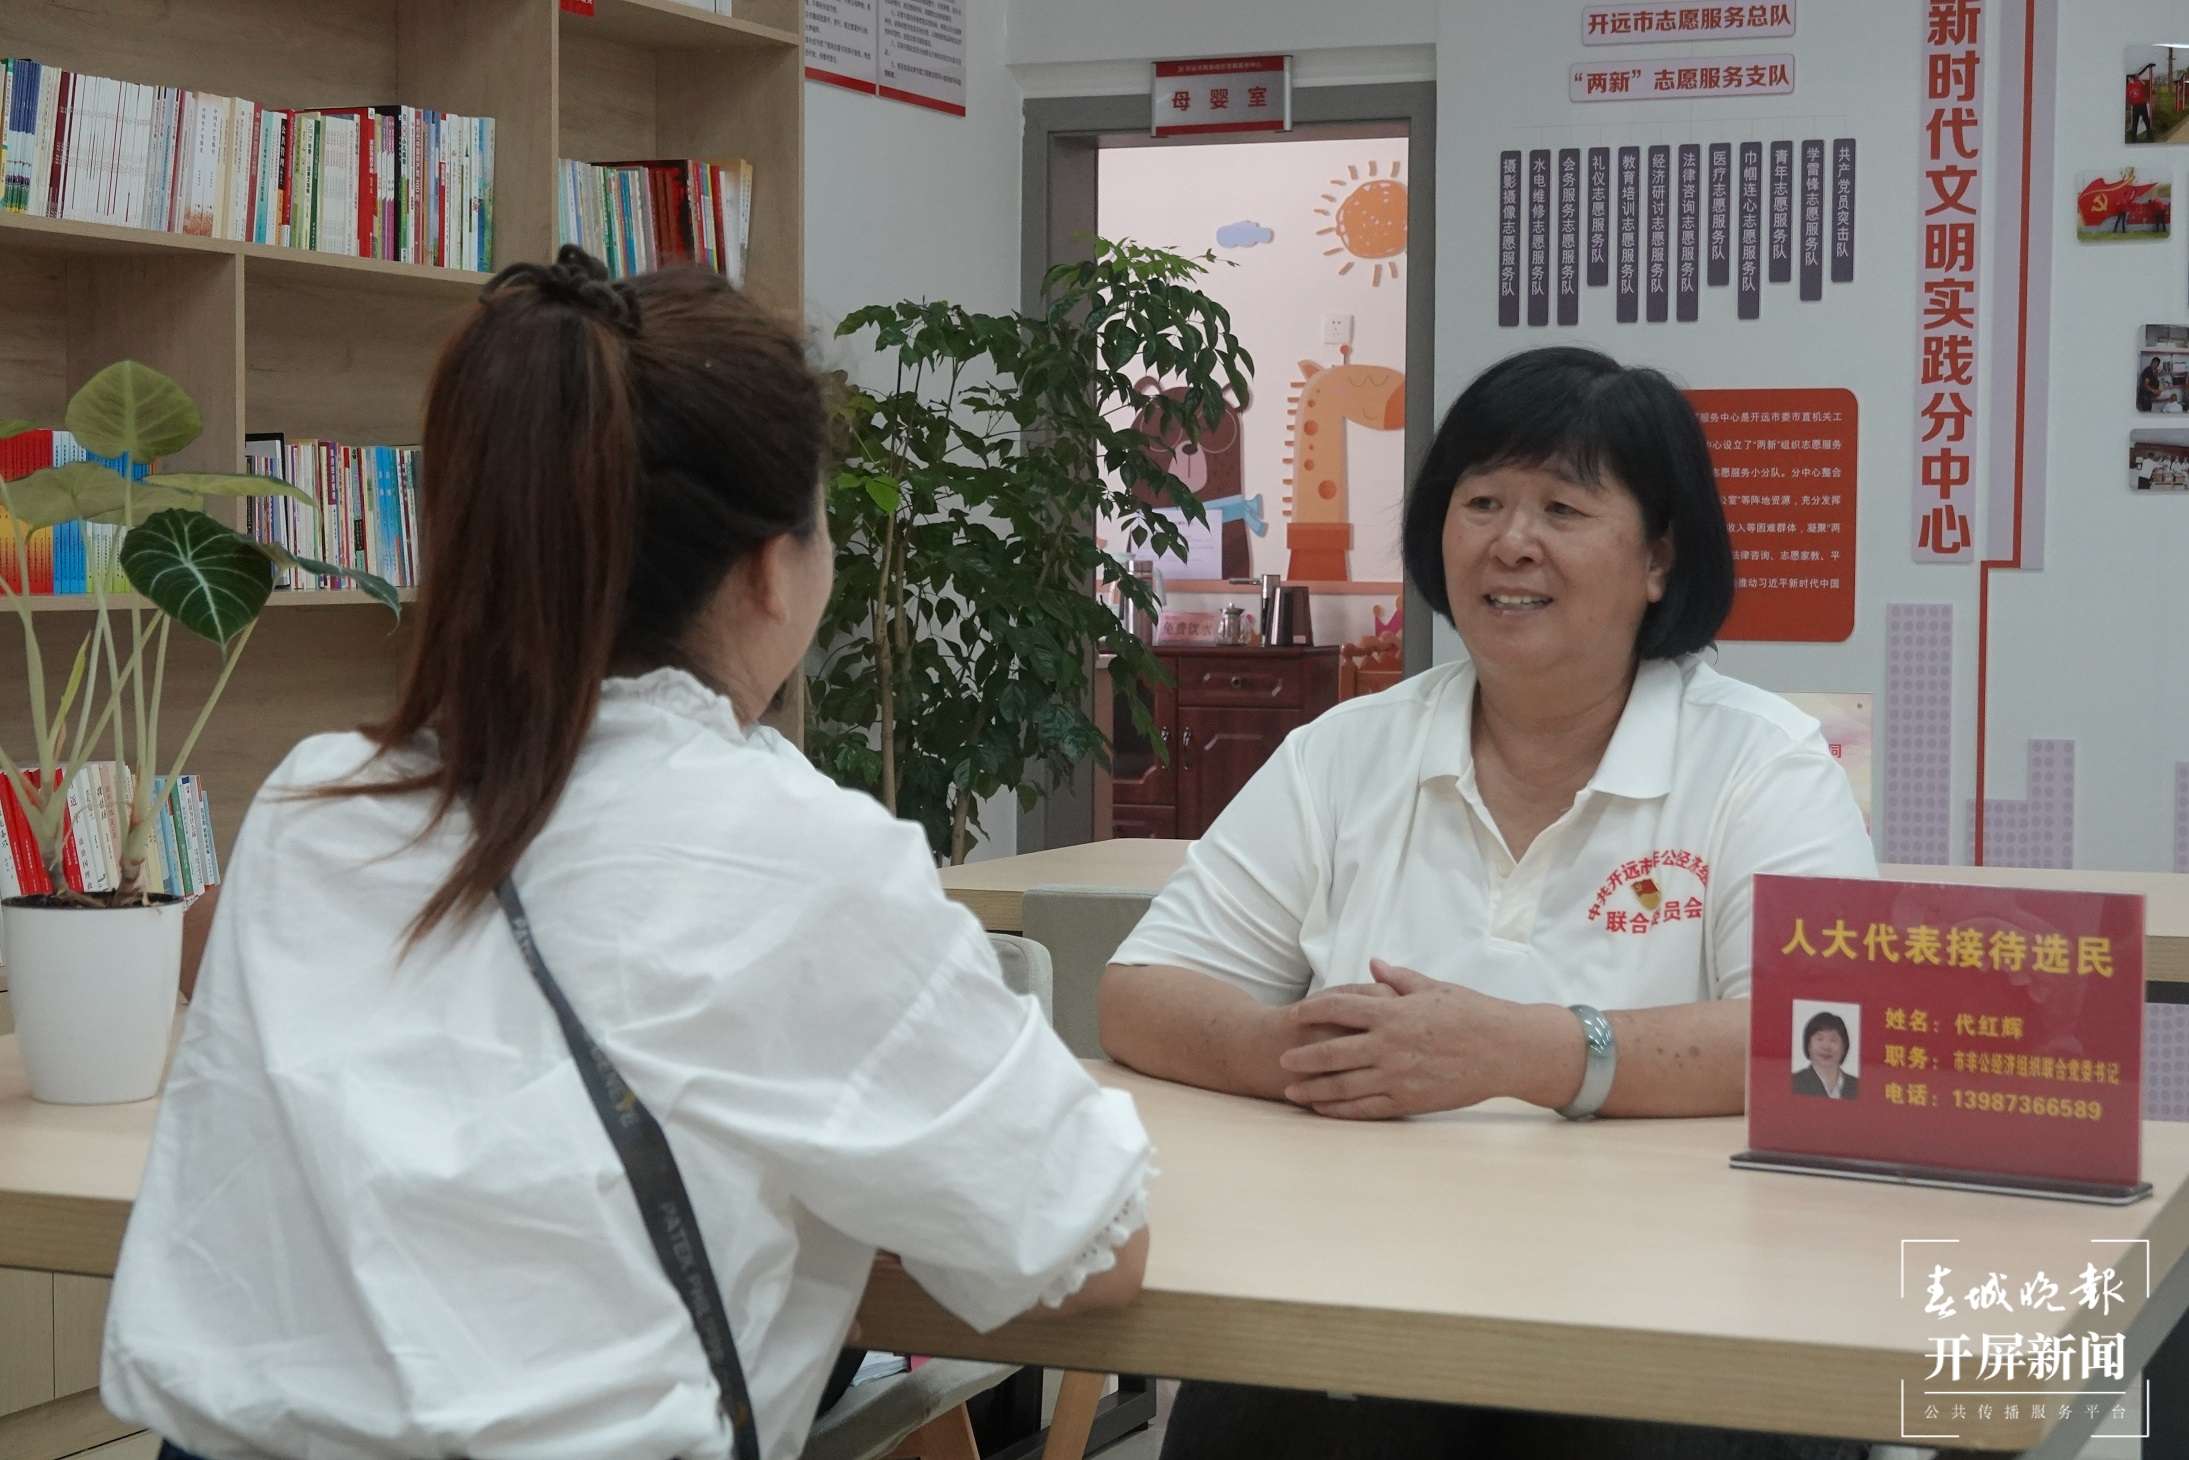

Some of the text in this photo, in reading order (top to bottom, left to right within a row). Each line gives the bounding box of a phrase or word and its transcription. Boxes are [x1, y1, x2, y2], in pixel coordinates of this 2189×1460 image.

[1588, 4, 1791, 35] 开远市志愿服务总队
[1171, 86, 1268, 111] 母婴室
[1501, 158, 1517, 296] 摄影摄像志愿服务队
[1531, 159, 1546, 295] 水电维修志愿服务队
[1561, 157, 1576, 295] 会务服务志愿服务队
[1591, 155, 1606, 263] 礼仪志愿服务队
[1621, 154, 1636, 294] 教育培训志愿服务队
[1650, 154, 1666, 293] 经济研讨志愿服务队
[1680, 152, 1696, 292] 法律咨询志愿服务队
[1711, 151, 1727, 260] 医疗志愿服务队
[1742, 150, 1758, 291] 巾帼连心志愿服务队
[1772, 149, 1789, 259] 青年志愿服务队
[1804, 146, 1820, 266] 学雷锋志愿服务队
[1836, 147, 1850, 258] 共产党员突击队
[1918, 0, 1981, 555] 新时代文明实践分中心
[1735, 578, 1840, 590] 推动习近平新时代中国
[1781, 919, 2114, 978] 人大代表接待选民
